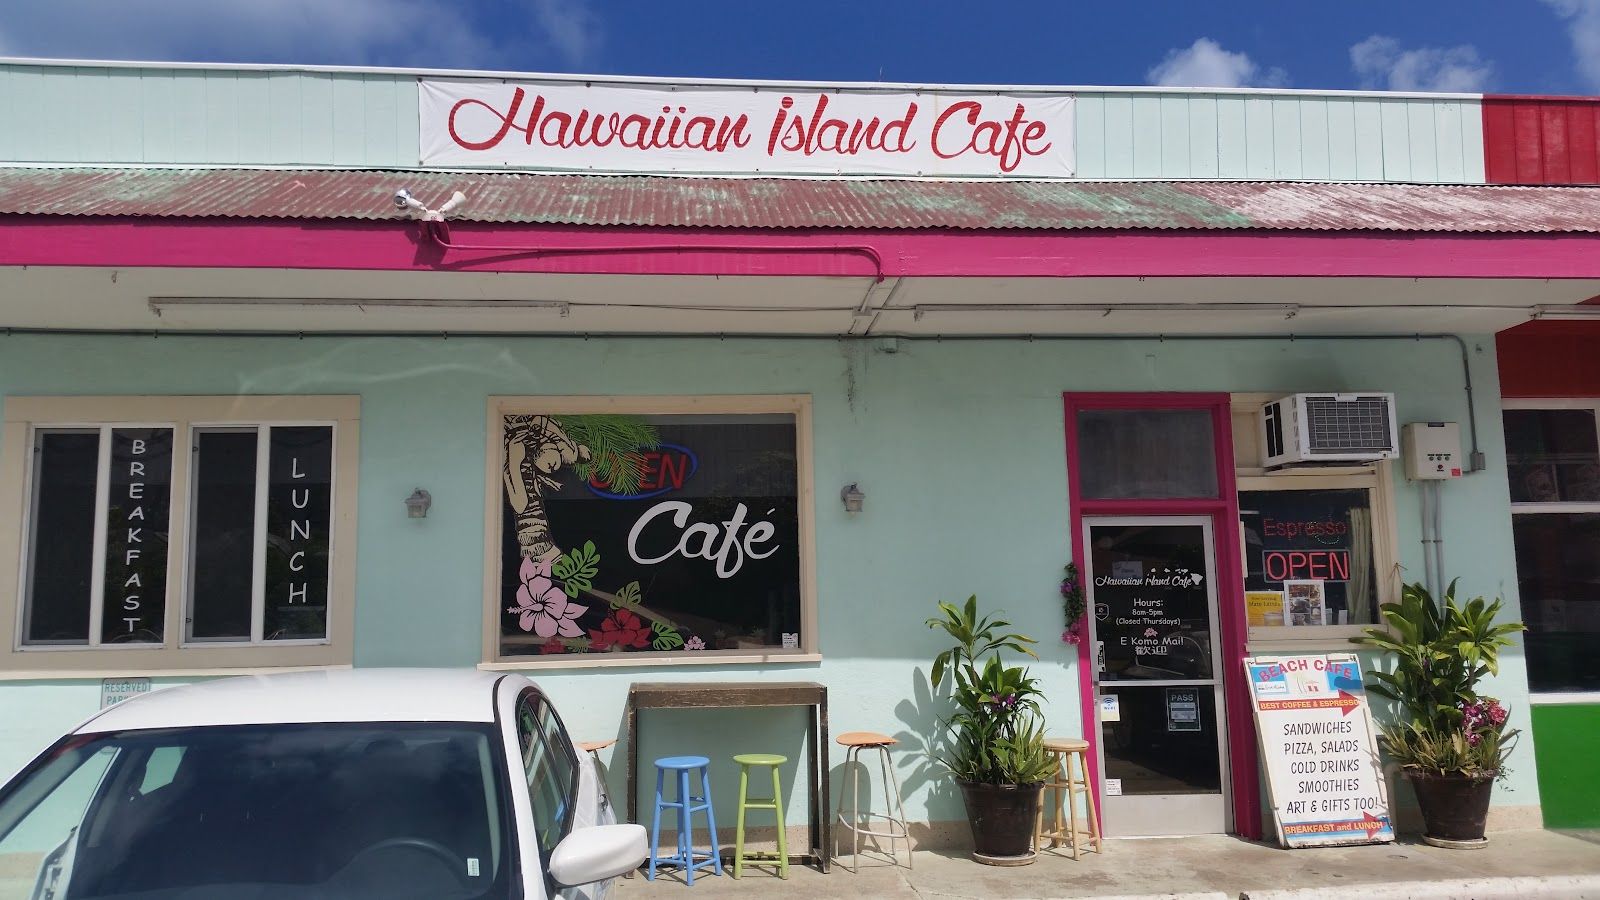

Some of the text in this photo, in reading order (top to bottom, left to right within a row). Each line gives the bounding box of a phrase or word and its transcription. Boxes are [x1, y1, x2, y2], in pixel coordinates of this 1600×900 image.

[448, 87, 752, 152] Hawaiian
[931, 101, 1052, 172] Cafe
[123, 439, 147, 633] BREAKFAST
[288, 457, 309, 604] LUNCH
[1263, 518, 1347, 541] Espresso
[628, 501, 780, 579] Café
[1266, 551, 1349, 580] OPEN
[1095, 575, 1143, 587] Hawaiian
[1171, 575, 1192, 589] Cafe
[1133, 597, 1164, 607] Hours:
[1132, 608, 1164, 617] 8am-5pm
[1115, 617, 1181, 627] (Closed Thursdays)
[1120, 636, 1128, 646] E
[1131, 637, 1159, 646] Komo
[1258, 659, 1352, 682] BEACH CAFE
[104, 682, 148, 693] RESERVED
[1170, 693, 1195, 702] PASS
[1260, 702, 1281, 710] BEST
[1282, 701, 1312, 709] COFFEE
[1319, 699, 1360, 708] ESPRESSO
[1283, 721, 1352, 736] SANDWICHES
[1284, 739, 1359, 756] PIZZA, SALADS
[1290, 759, 1360, 774] COLD DRINKS
[1298, 778, 1359, 794] SMOOTHIES
[1286, 796, 1378, 814] ART & GIFTS TOO!
[1284, 821, 1383, 835] BREAKFAST and LUNCH
